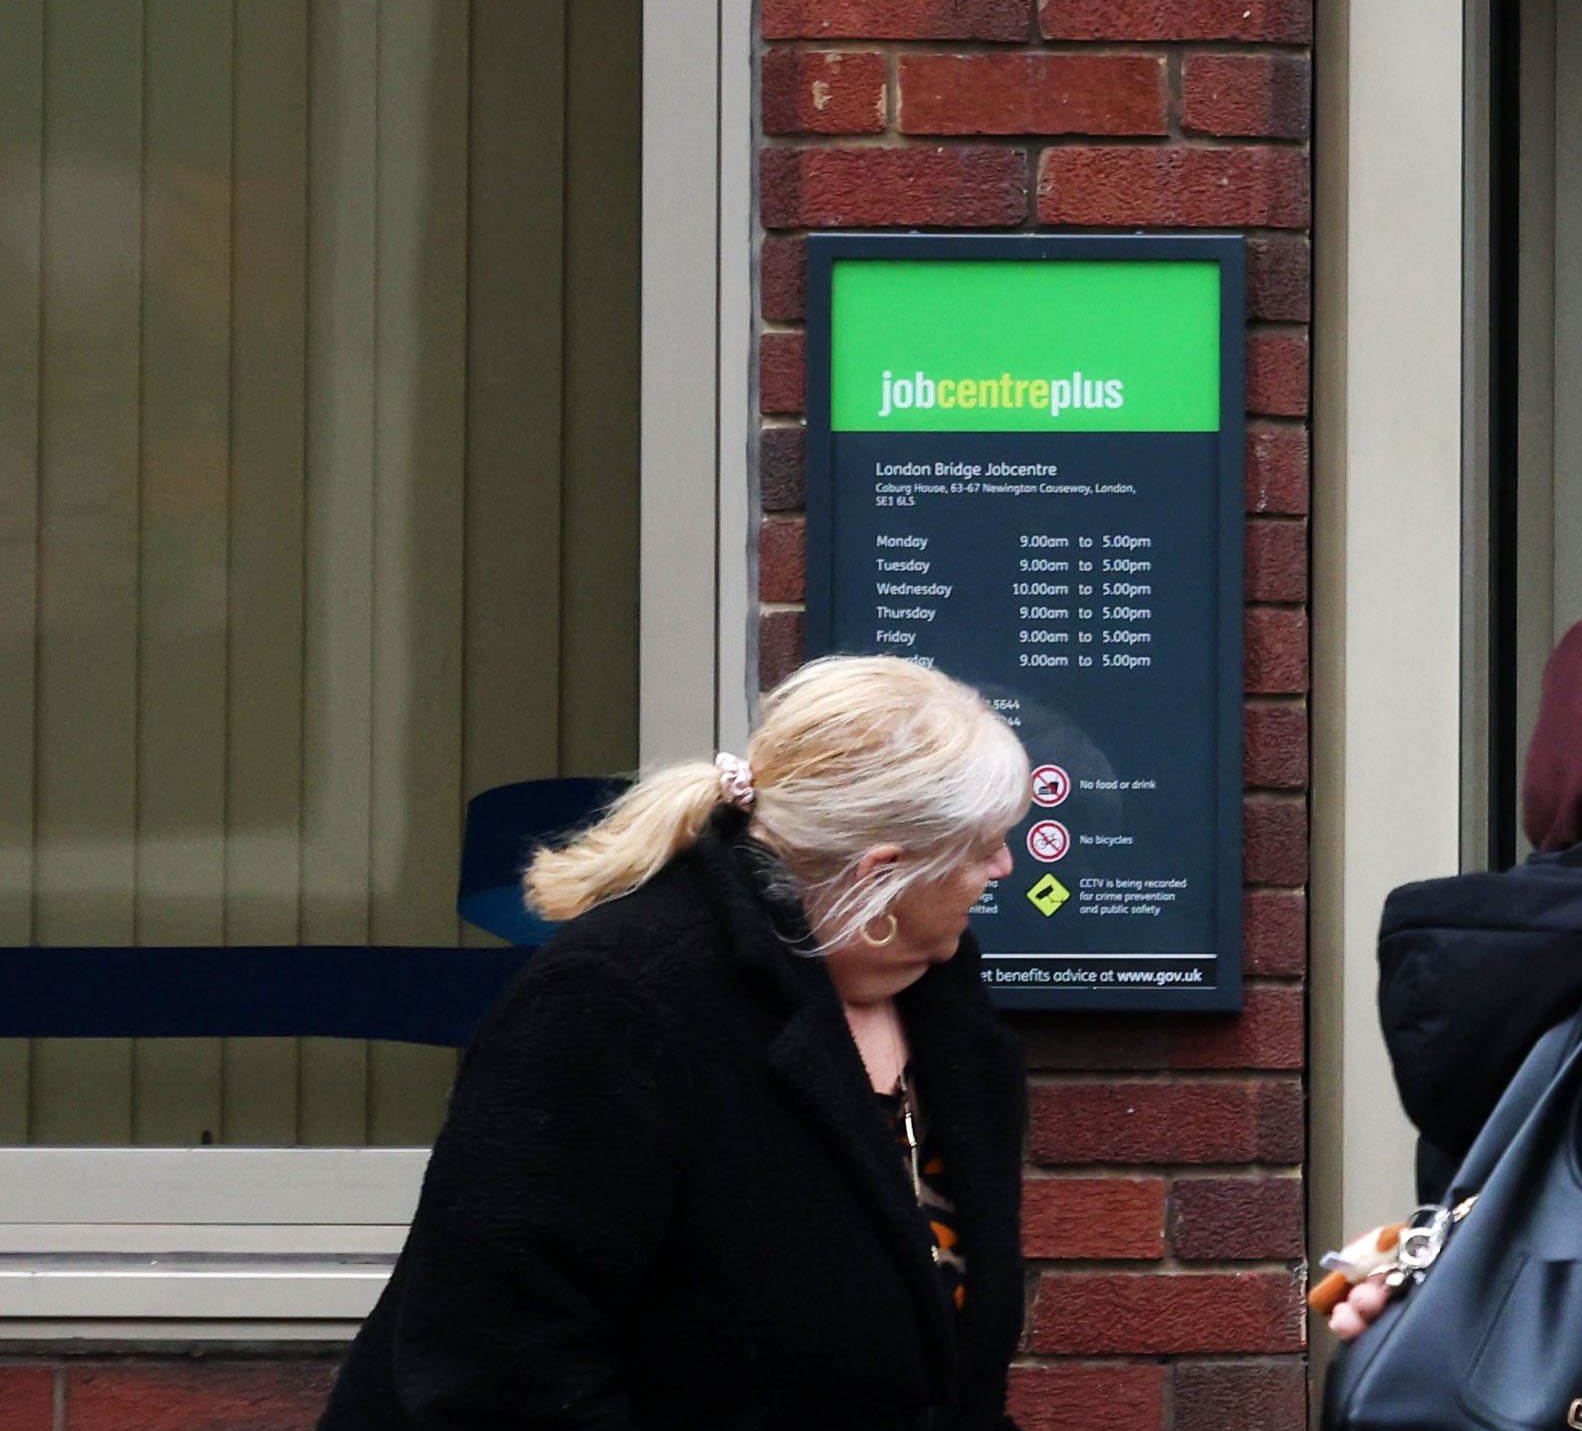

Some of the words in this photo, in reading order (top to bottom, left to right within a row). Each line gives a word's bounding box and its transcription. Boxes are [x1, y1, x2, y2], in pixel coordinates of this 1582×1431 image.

[878, 370, 1124, 417] jobcentreplus
[875, 462, 931, 476] London
[935, 462, 982, 479] Bridge
[985, 462, 1058, 476] Jobcentre
[1095, 483, 1136, 494] London,
[876, 536, 928, 550] Monday
[1019, 536, 1069, 548] 9.00am
[1078, 536, 1093, 548] to
[1102, 536, 1151, 550] 5.00pm
[876, 559, 930, 574] Tuesday
[1019, 559, 1069, 571] 9.00am
[1078, 559, 1093, 571] to
[1102, 559, 1151, 574] 5.00pm
[876, 583, 952, 598] Wednesday
[1012, 583, 1069, 595] 10.00am
[1078, 583, 1093, 595] to
[1102, 583, 1151, 598] 5.00pm
[876, 607, 936, 621] Thursday
[1019, 607, 1069, 619] 9.00am
[1078, 607, 1093, 619] to
[1102, 607, 1151, 621] 5.00pm
[876, 630, 916, 645] Friday
[1019, 630, 1069, 642] 9.00am
[1078, 630, 1093, 642] to
[1102, 630, 1151, 645] 5.00pm
[1019, 654, 1069, 666] 9.00am
[1078, 654, 1093, 666] to
[1102, 654, 1151, 669] 5.00pm
[1079, 780, 1094, 789] No
[1095, 779, 1117, 789] food
[1131, 779, 1156, 789] drink
[1079, 835, 1094, 845] No
[1095, 835, 1133, 847] bicycles
[1105, 879, 1114, 888] is
[1115, 879, 1142, 891] being
[1144, 879, 1187, 888] recorded
[1079, 892, 1094, 901] for
[1095, 892, 1122, 901] crime
[1124, 892, 1176, 904] prevention
[1079, 905, 1099, 914] and
[1100, 904, 1129, 916] public
[1131, 905, 1161, 916] safety
[981, 970, 994, 982] et
[995, 968, 1051, 982] benefits
[1053, 968, 1097, 982] advice
[1099, 970, 1115, 982] at
[1116, 969, 1203, 986] www.gov.uk
